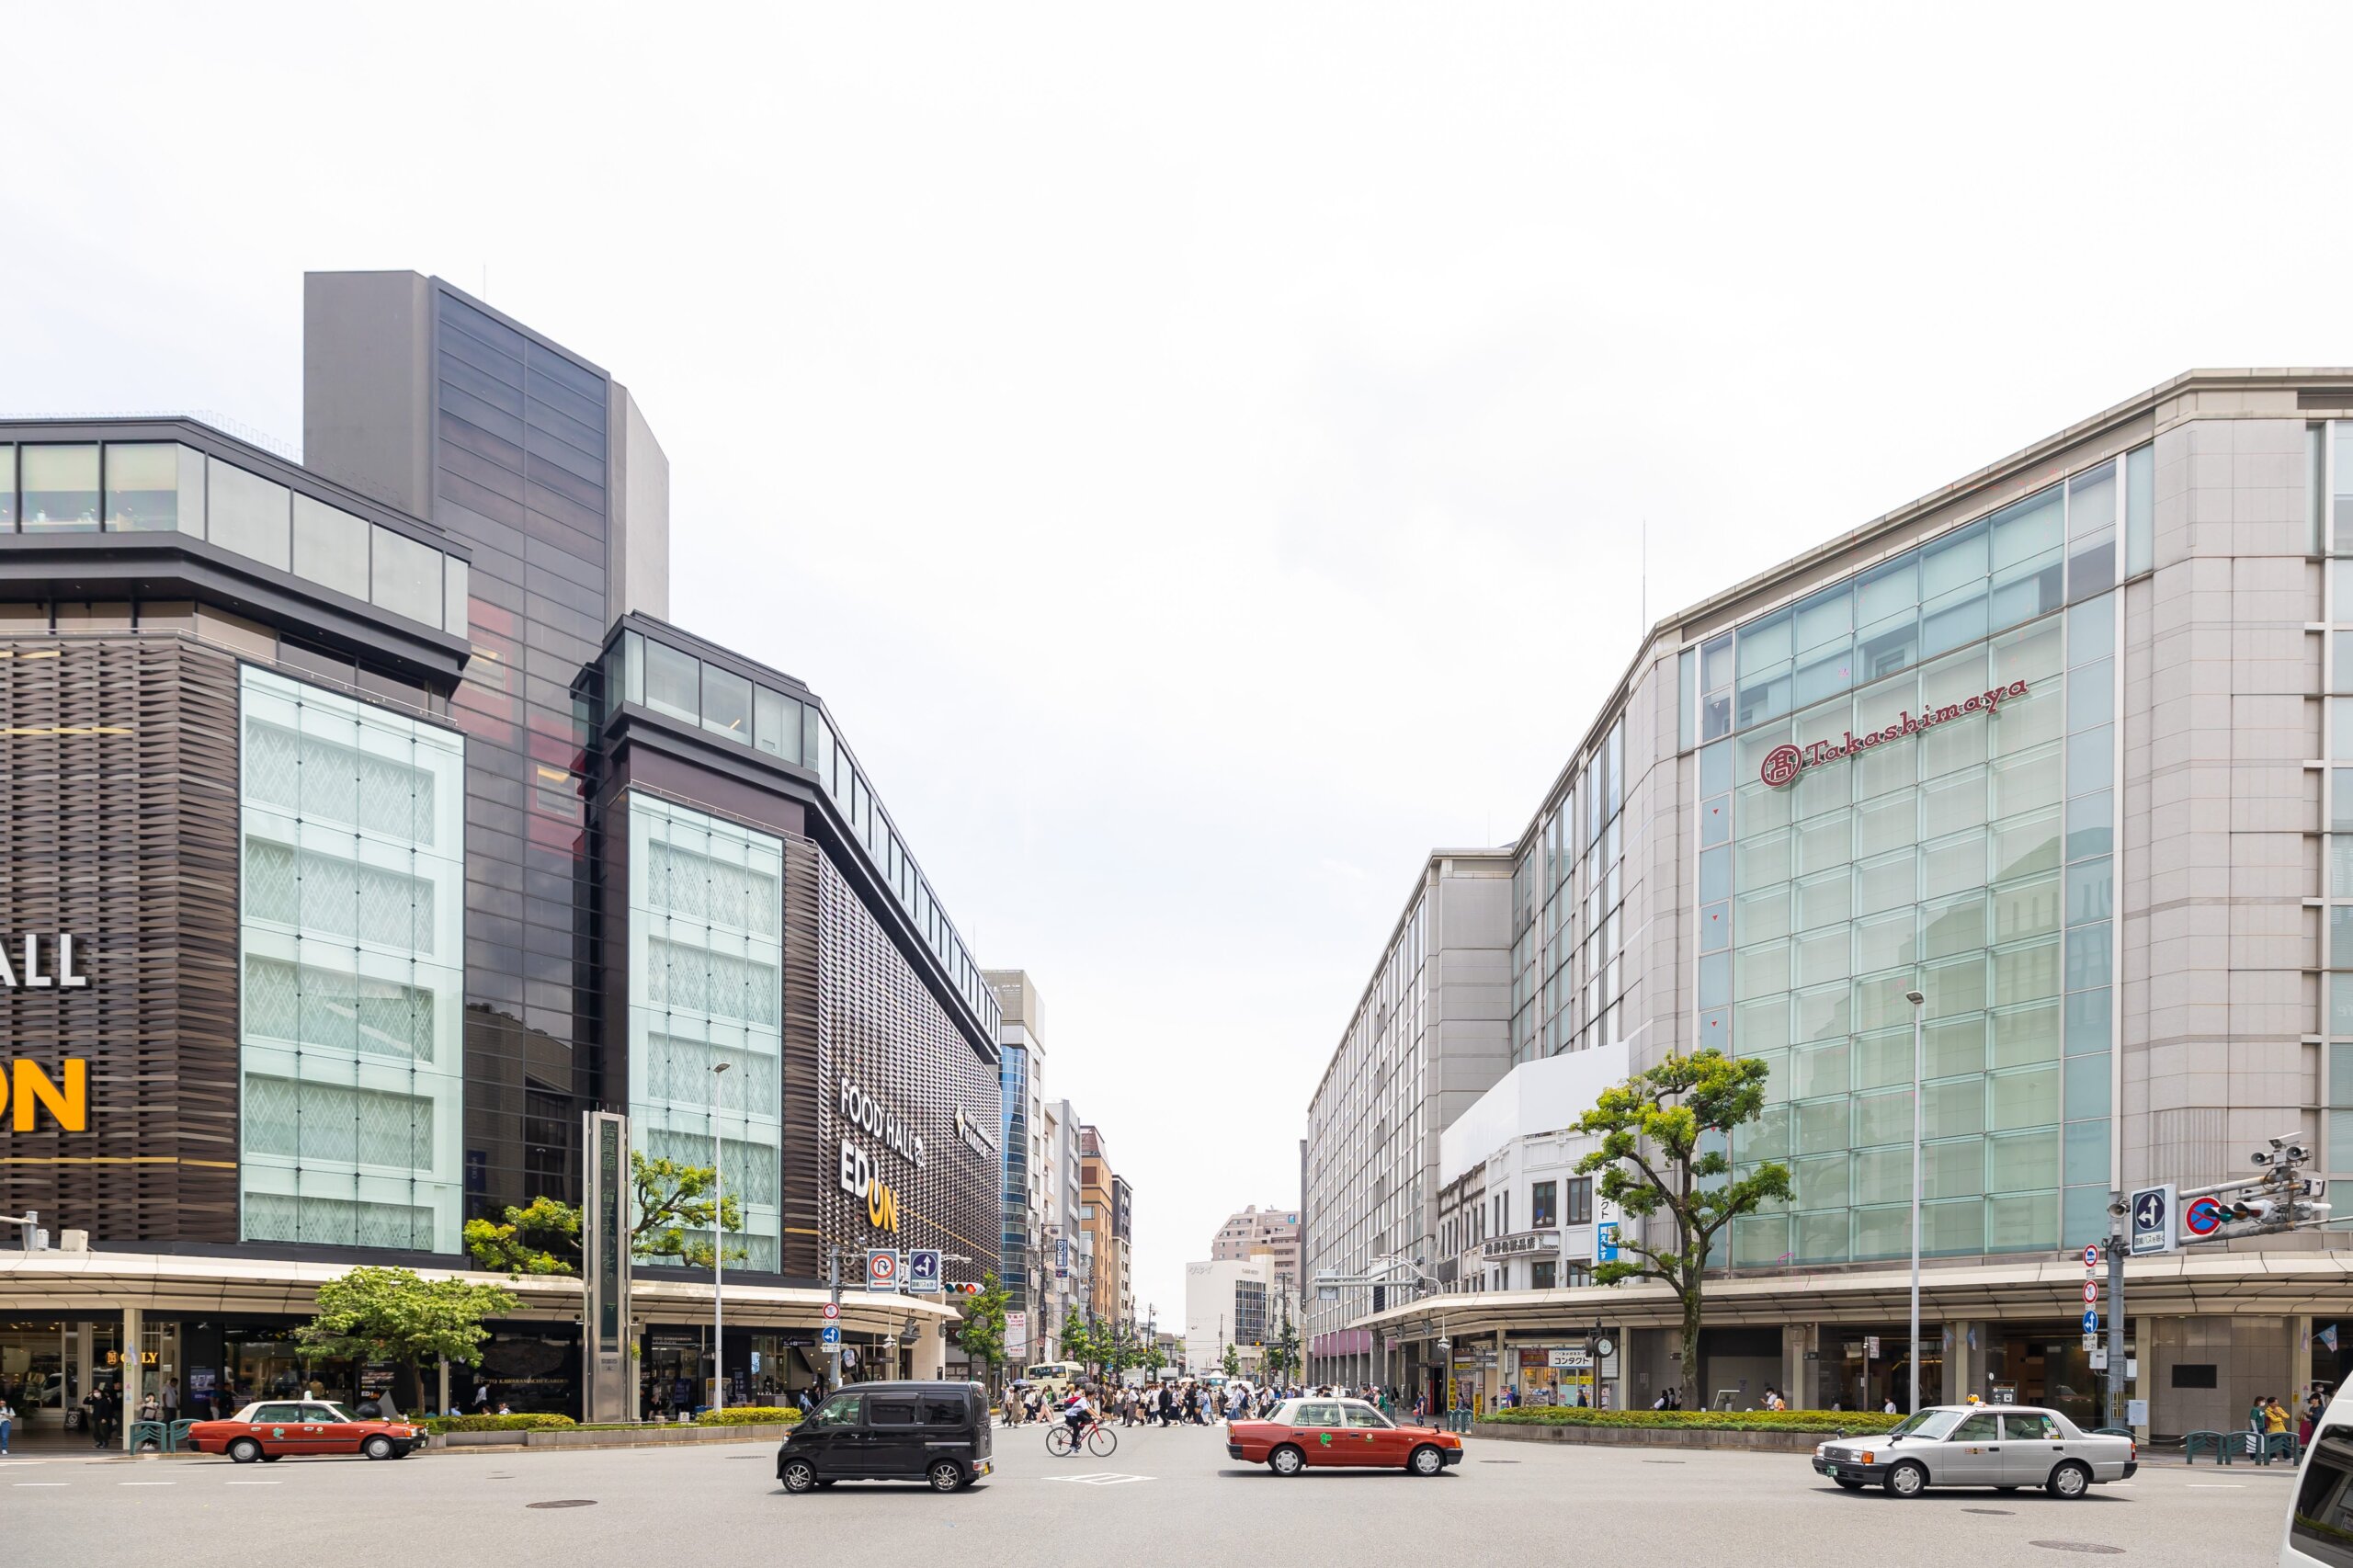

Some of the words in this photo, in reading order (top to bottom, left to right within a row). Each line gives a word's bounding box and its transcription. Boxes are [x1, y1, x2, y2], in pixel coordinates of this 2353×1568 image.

[1805, 679, 2029, 767] Takashimaya
[0, 1059, 85, 1131] N
[840, 1077, 883, 1139] FOOD
[886, 1112, 915, 1163] HALL
